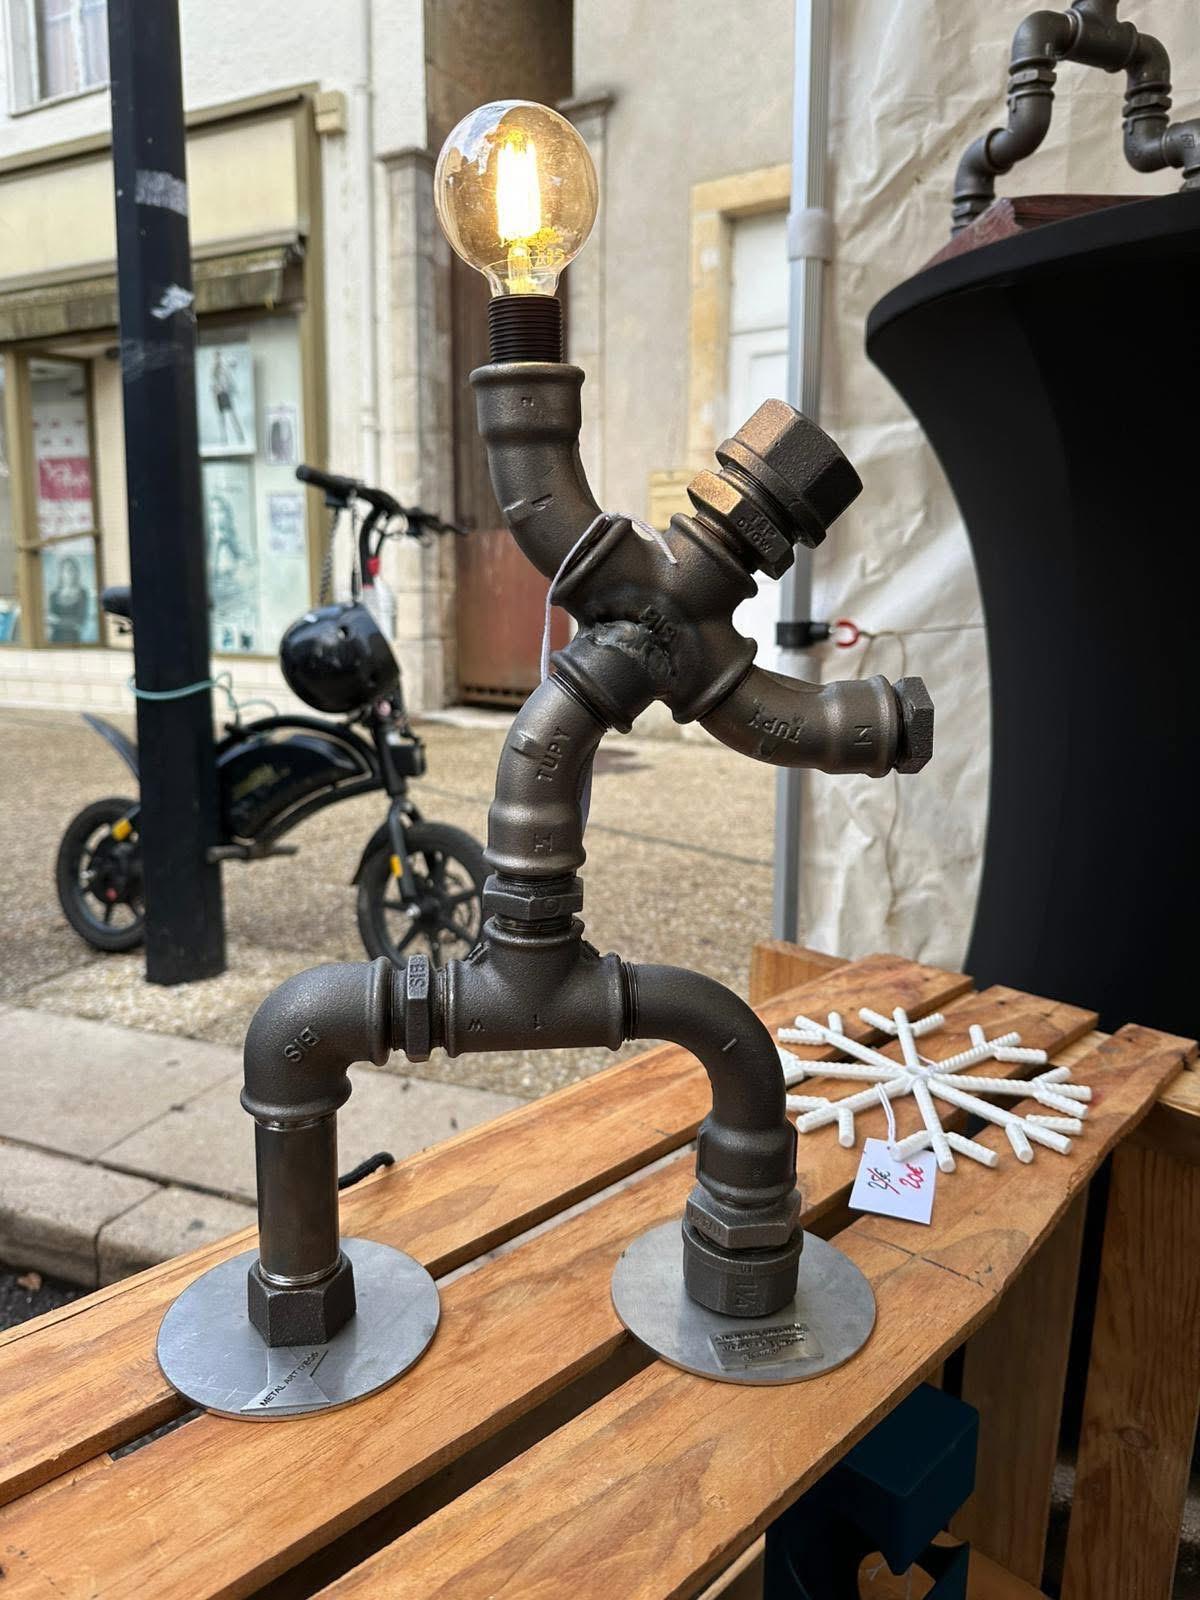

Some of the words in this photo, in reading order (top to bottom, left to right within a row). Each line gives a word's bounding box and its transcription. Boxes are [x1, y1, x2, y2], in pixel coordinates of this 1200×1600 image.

[536, 725, 571, 783] TUPY
[284, 1025, 321, 1063] SIB
[259, 1384, 287, 1407] METAL
[284, 1369, 299, 1385] ART
